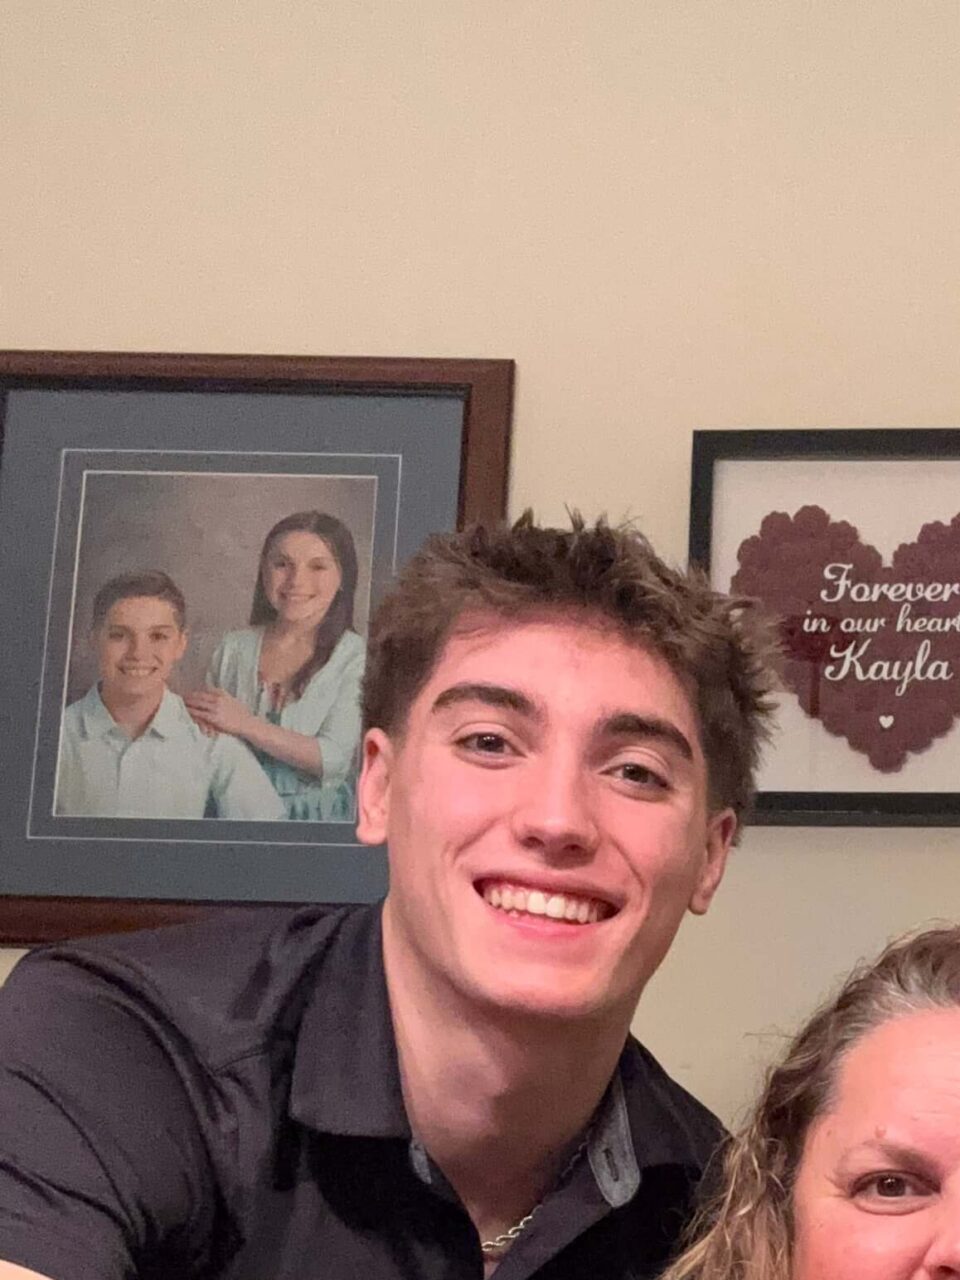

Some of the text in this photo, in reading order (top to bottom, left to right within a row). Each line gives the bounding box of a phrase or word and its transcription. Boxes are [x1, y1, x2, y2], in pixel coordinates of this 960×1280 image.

[820, 563, 960, 602] Forever
[803, 609, 830, 632] in
[840, 617, 886, 632] our
[824, 638, 954, 696] Kayla
